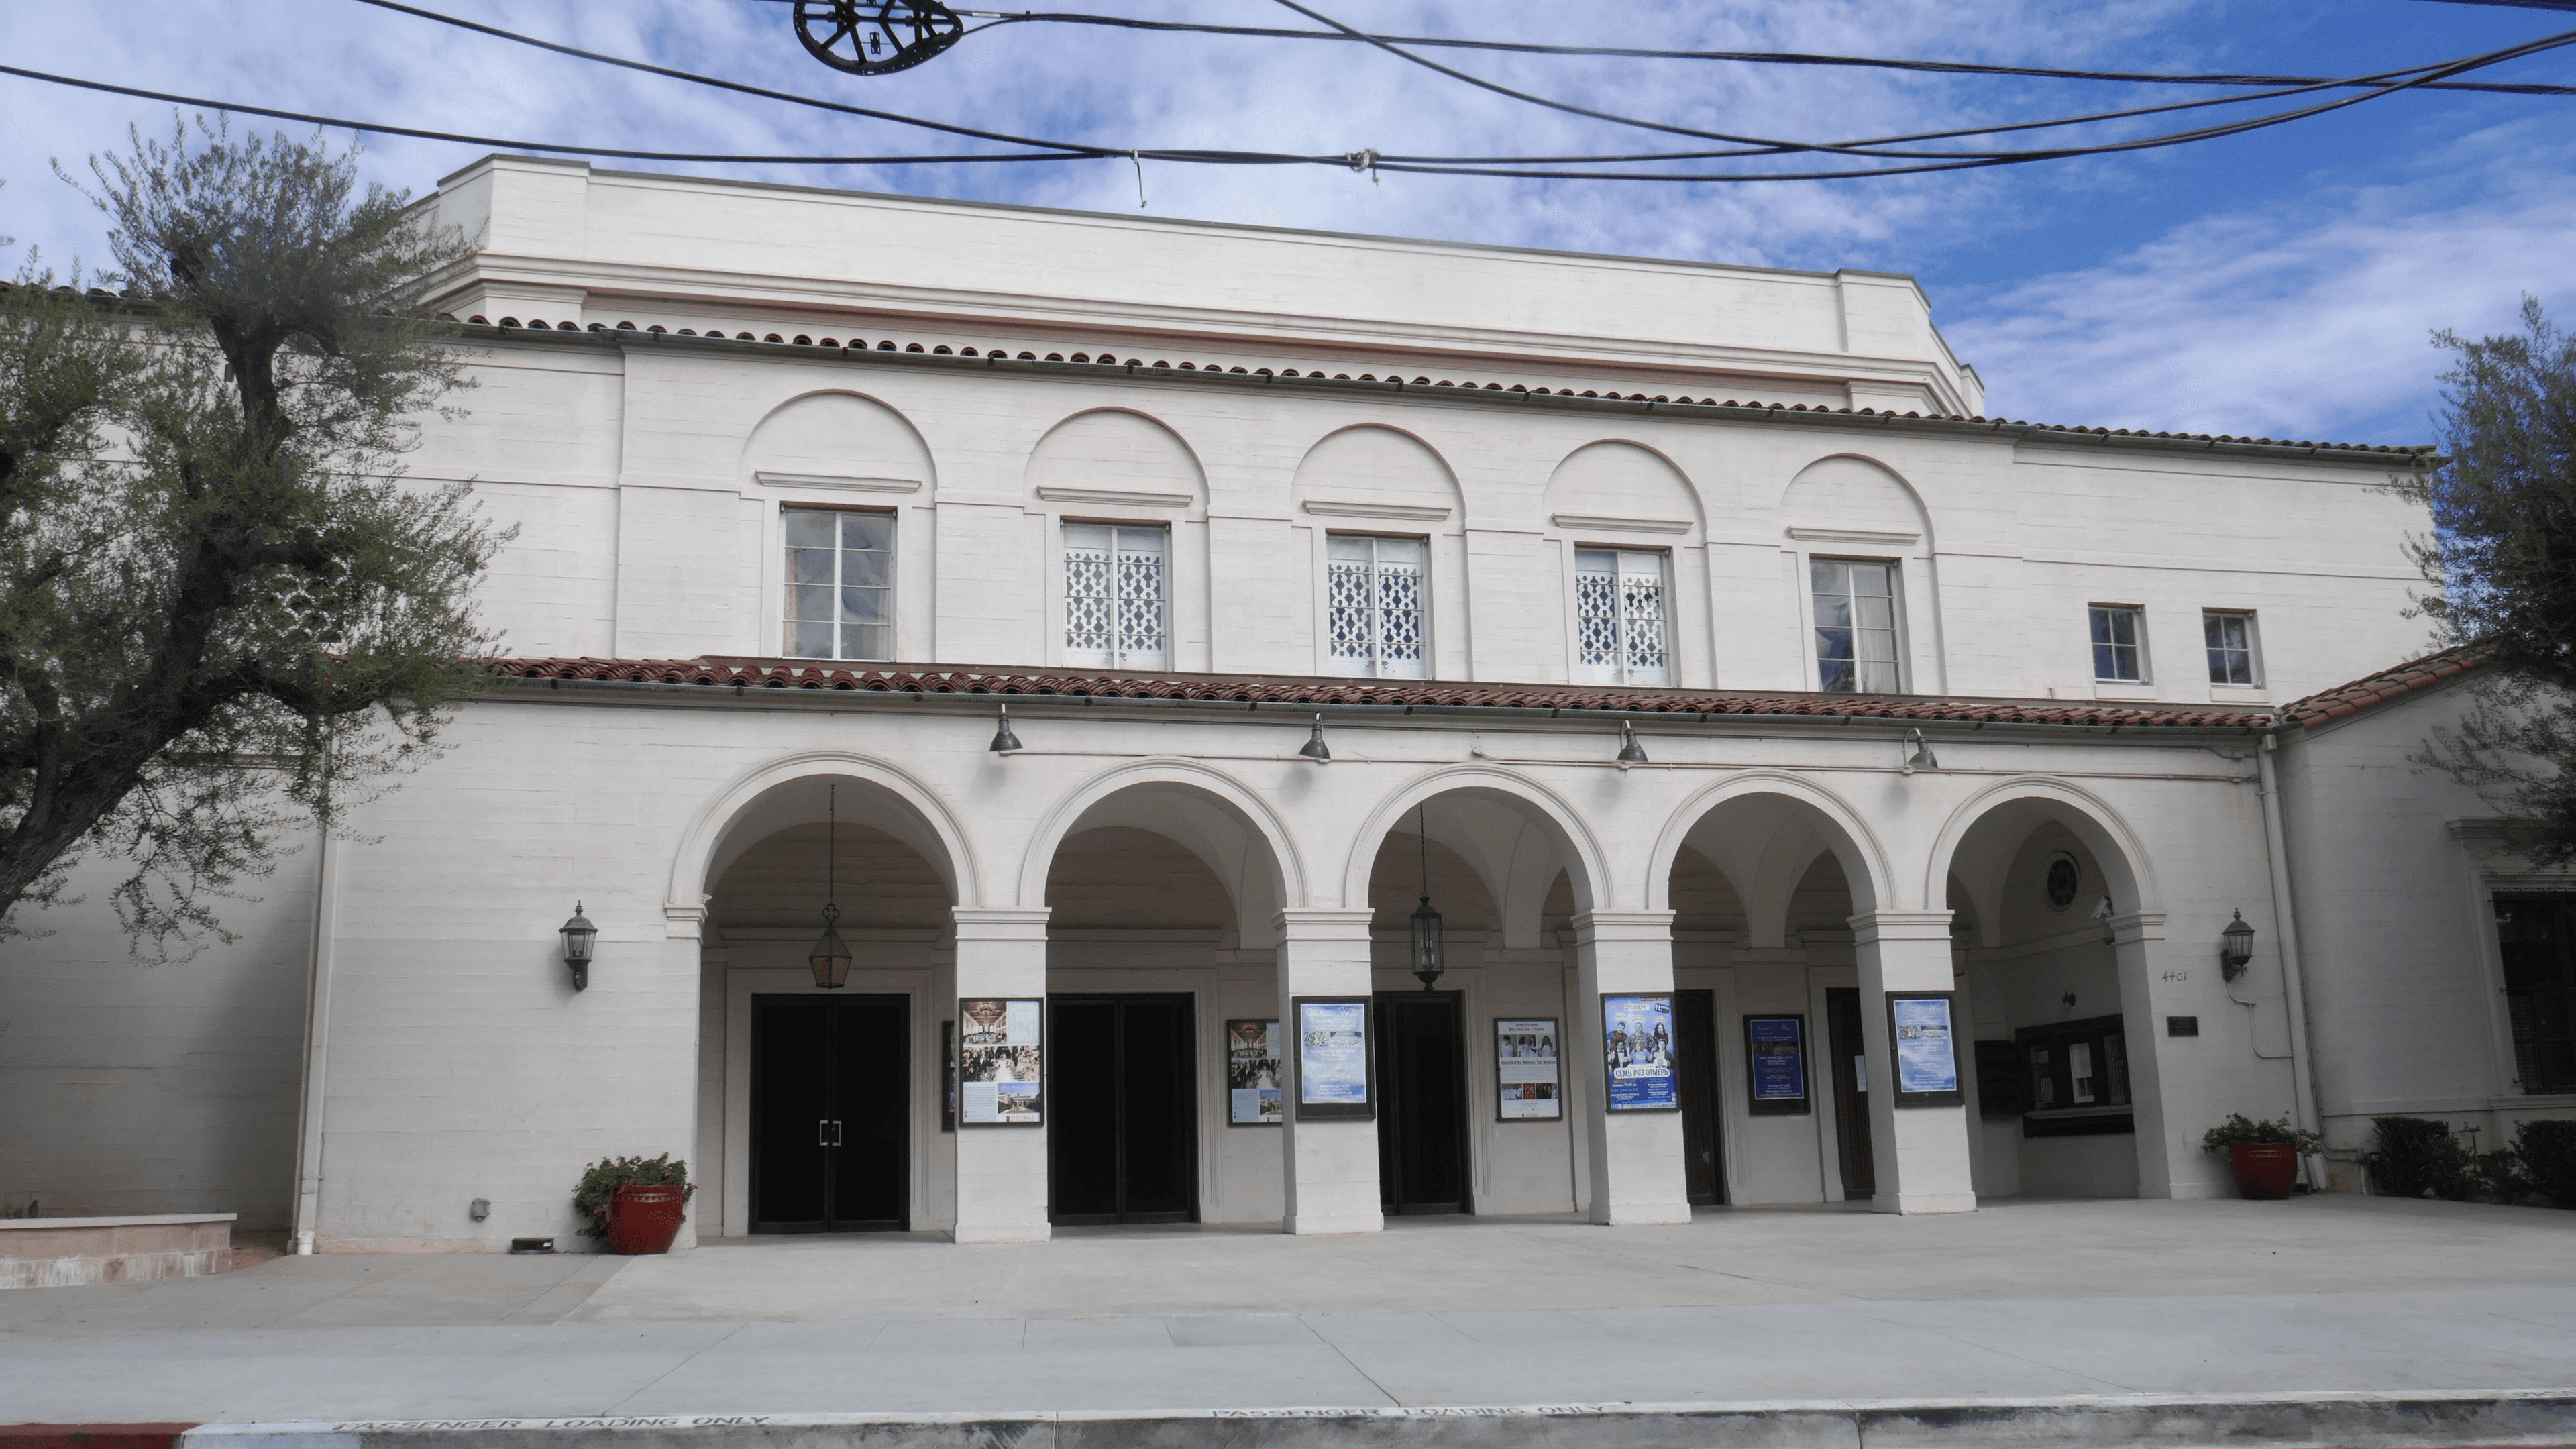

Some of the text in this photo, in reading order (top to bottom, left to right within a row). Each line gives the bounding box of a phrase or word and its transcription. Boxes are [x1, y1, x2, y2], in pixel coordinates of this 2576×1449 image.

[2162, 971, 2187, 983] 4401
[1646, 1069, 1668, 1077] ОТМЕРЬ
[1212, 1409, 1380, 1417] PASSENGER
[1537, 1405, 1605, 1413] ONLY
[333, 1416, 770, 1430] PASSENGER LOADING ONLY
